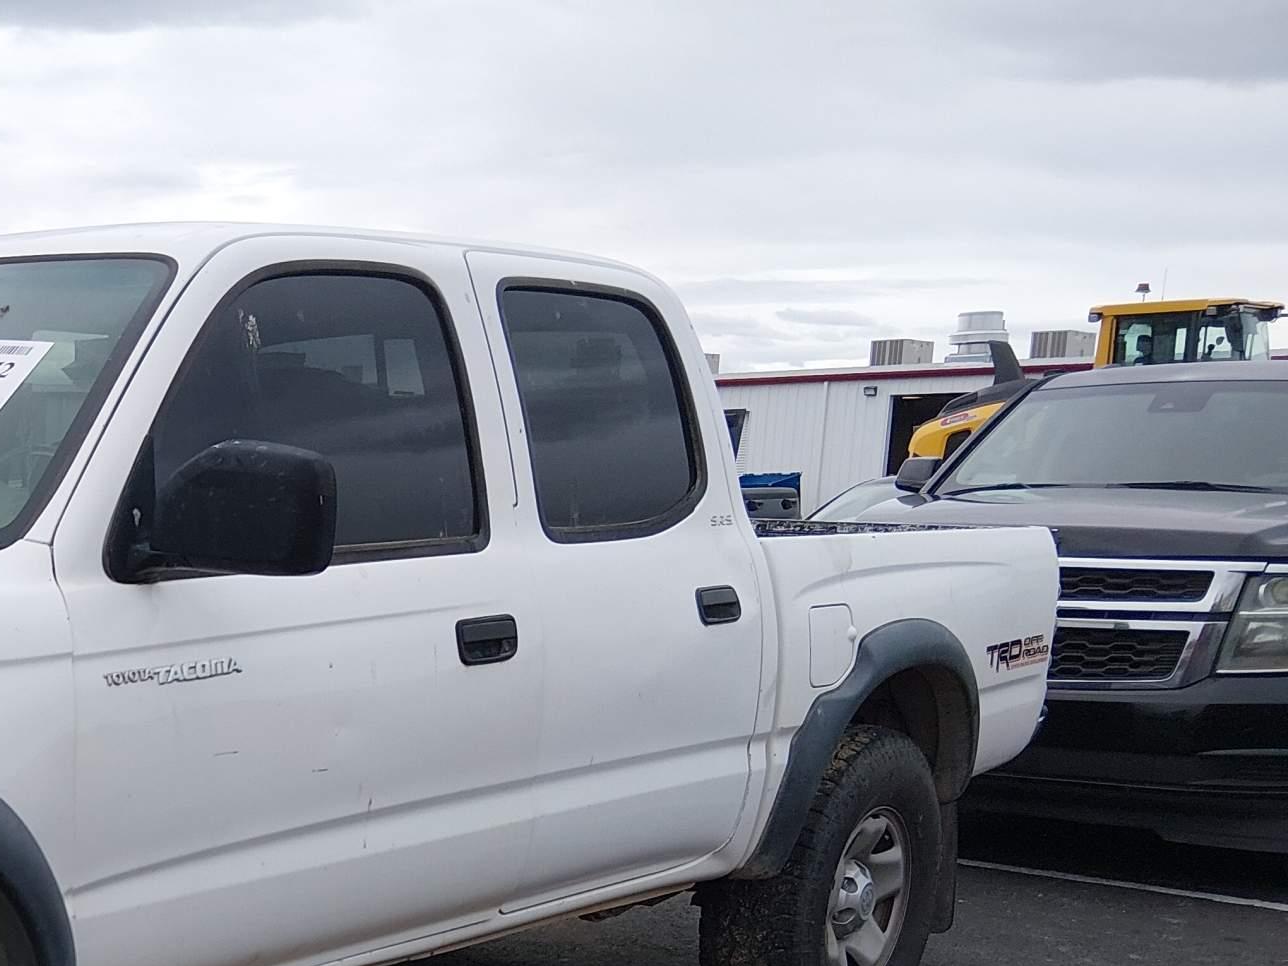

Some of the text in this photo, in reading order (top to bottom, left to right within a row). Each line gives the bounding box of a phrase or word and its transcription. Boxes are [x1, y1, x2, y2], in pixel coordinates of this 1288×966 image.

[986, 638, 1022, 673] TRD
[1022, 644, 1049, 658] ROAD
[103, 658, 242, 687] TOYOTA TACOMA
